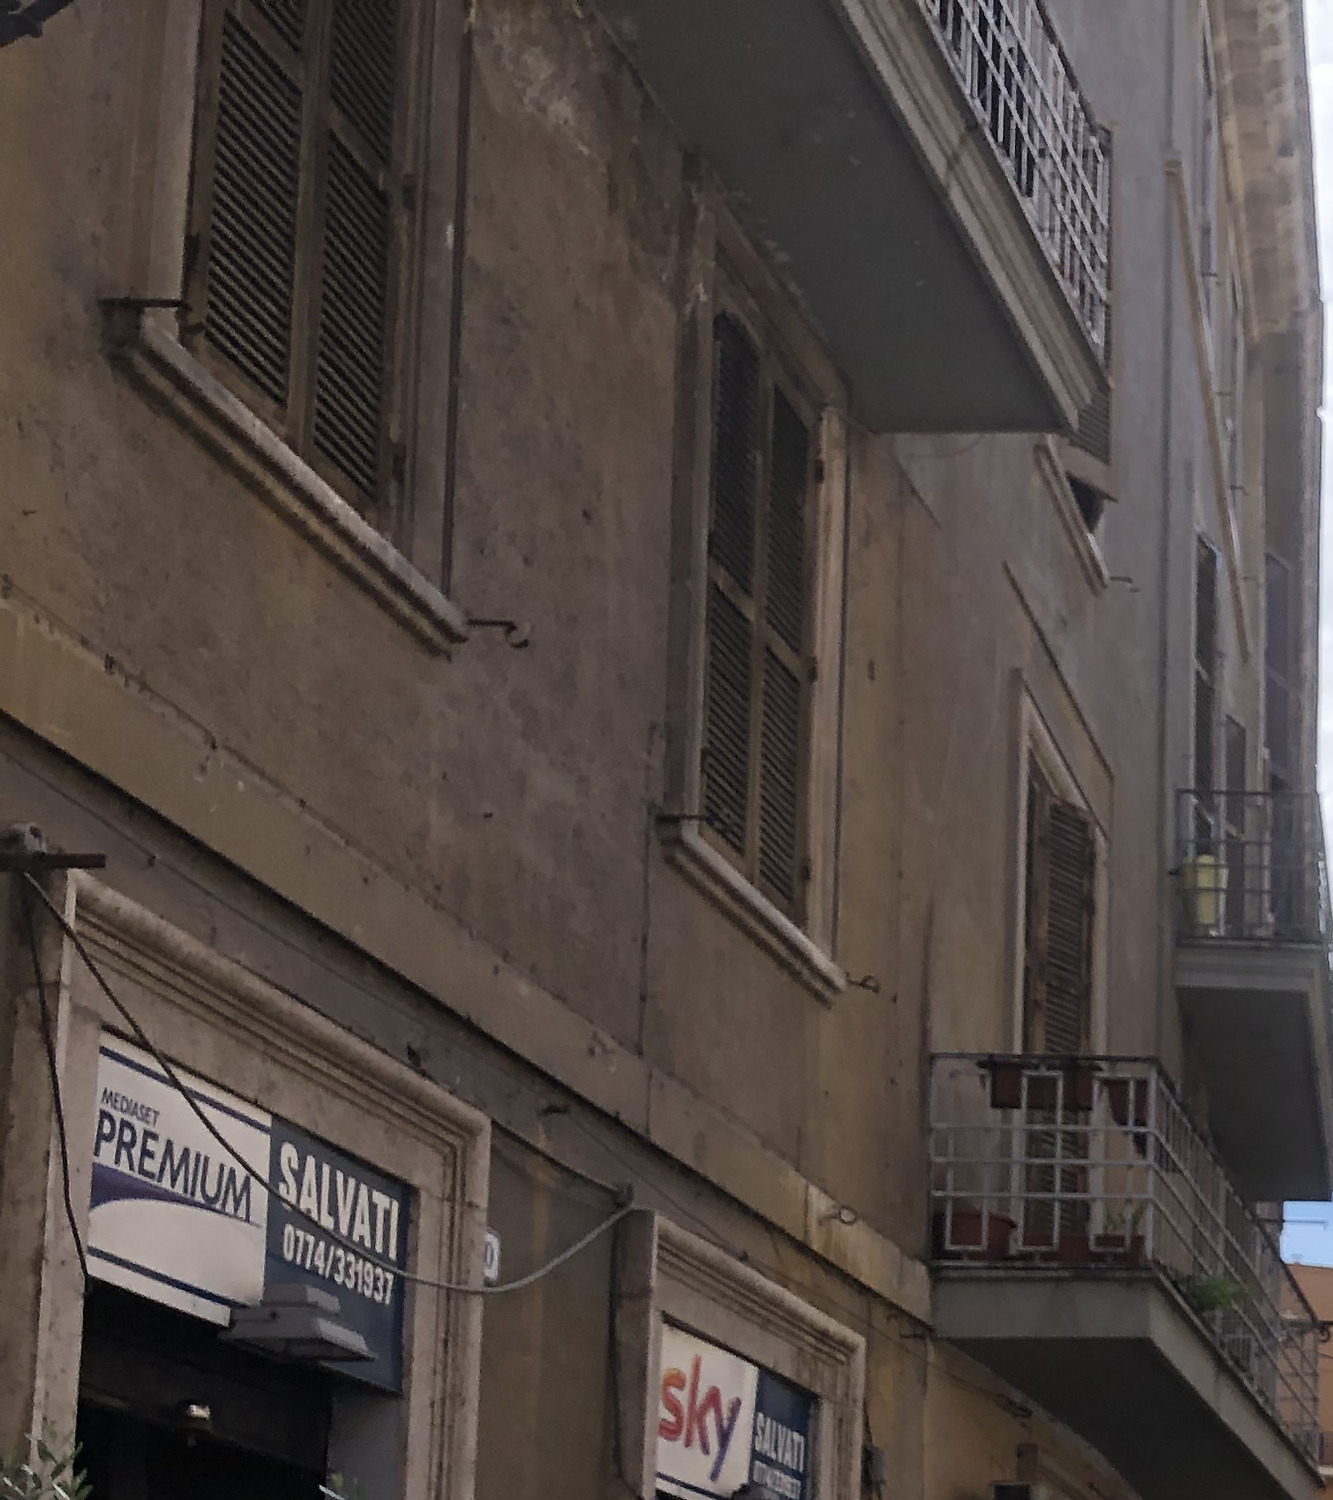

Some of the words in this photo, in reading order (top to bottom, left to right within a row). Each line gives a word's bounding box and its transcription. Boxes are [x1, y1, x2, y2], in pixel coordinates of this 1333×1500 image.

[100, 1086, 161, 1129] MEDIASET
[93, 1108, 251, 1225] PREMIUM
[278, 1142, 400, 1262] SALVATI
[283, 1223, 394, 1306] 0774/331937
[657, 1354, 742, 1483] sky
